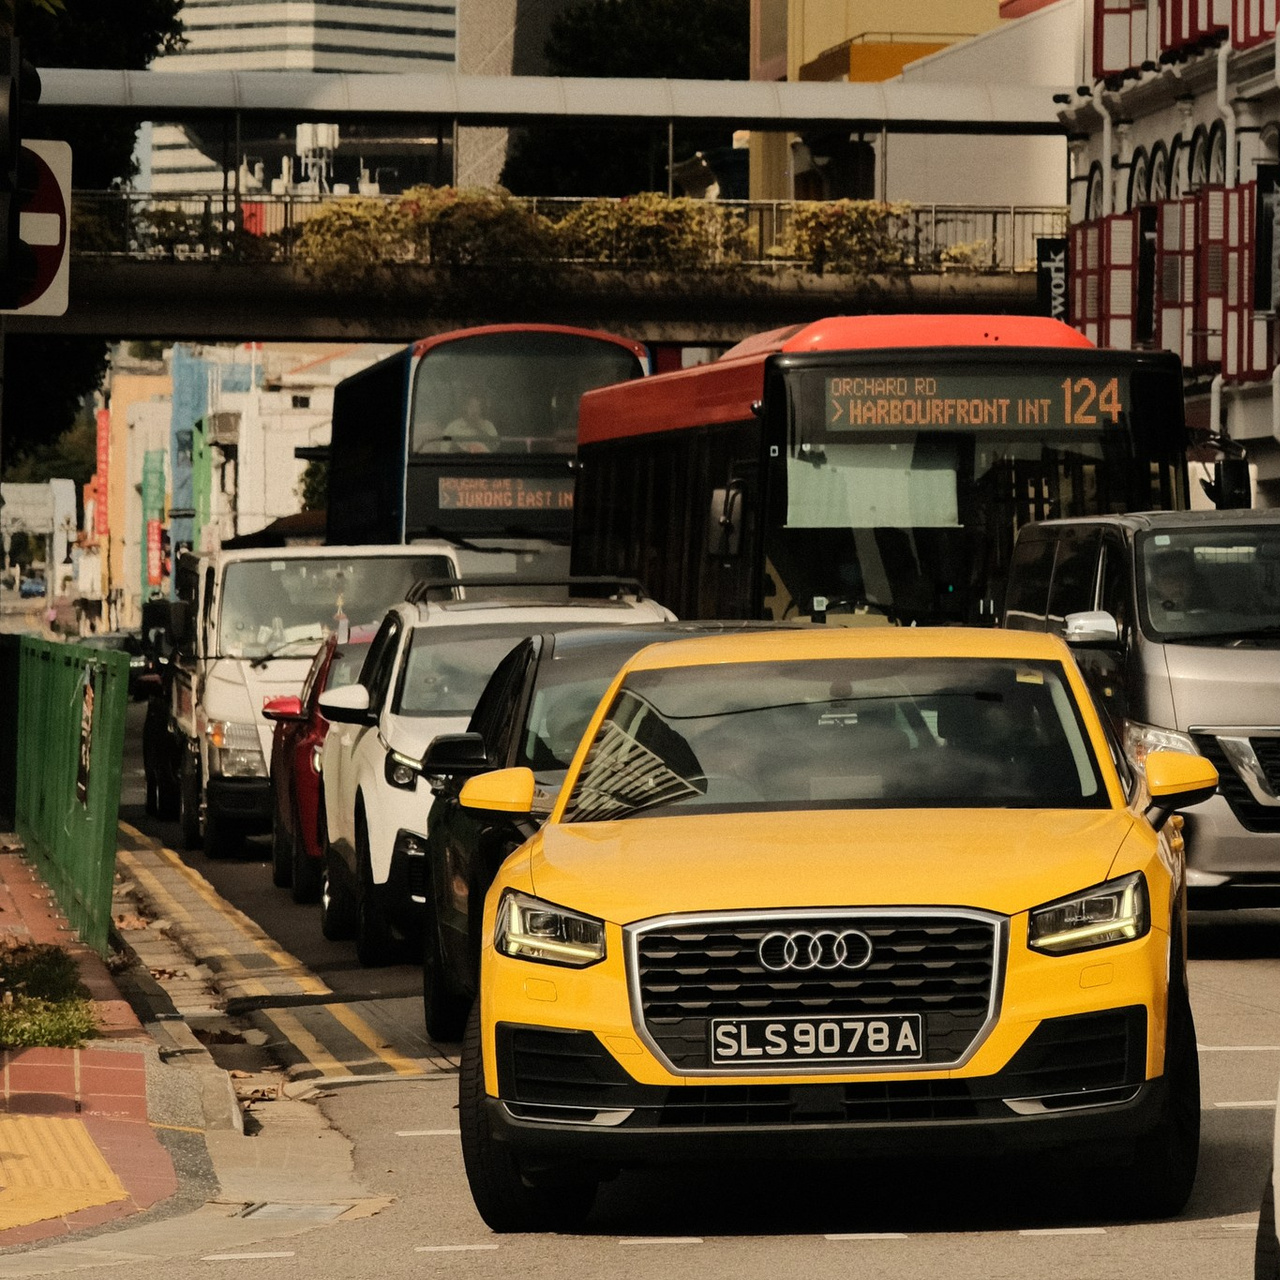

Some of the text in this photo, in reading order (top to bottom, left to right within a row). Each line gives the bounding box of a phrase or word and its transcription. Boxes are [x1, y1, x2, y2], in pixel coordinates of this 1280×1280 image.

[1041, 251, 1065, 322] work
[831, 377, 937, 396] ORCHARD RD
[1061, 377, 1122, 424] 124
[849, 399, 1051, 424] HARBOURFRONT INT
[456, 491, 513, 507] JURONG
[517, 491, 552, 507] EAST
[716, 1021, 917, 1056] SLS9078A
